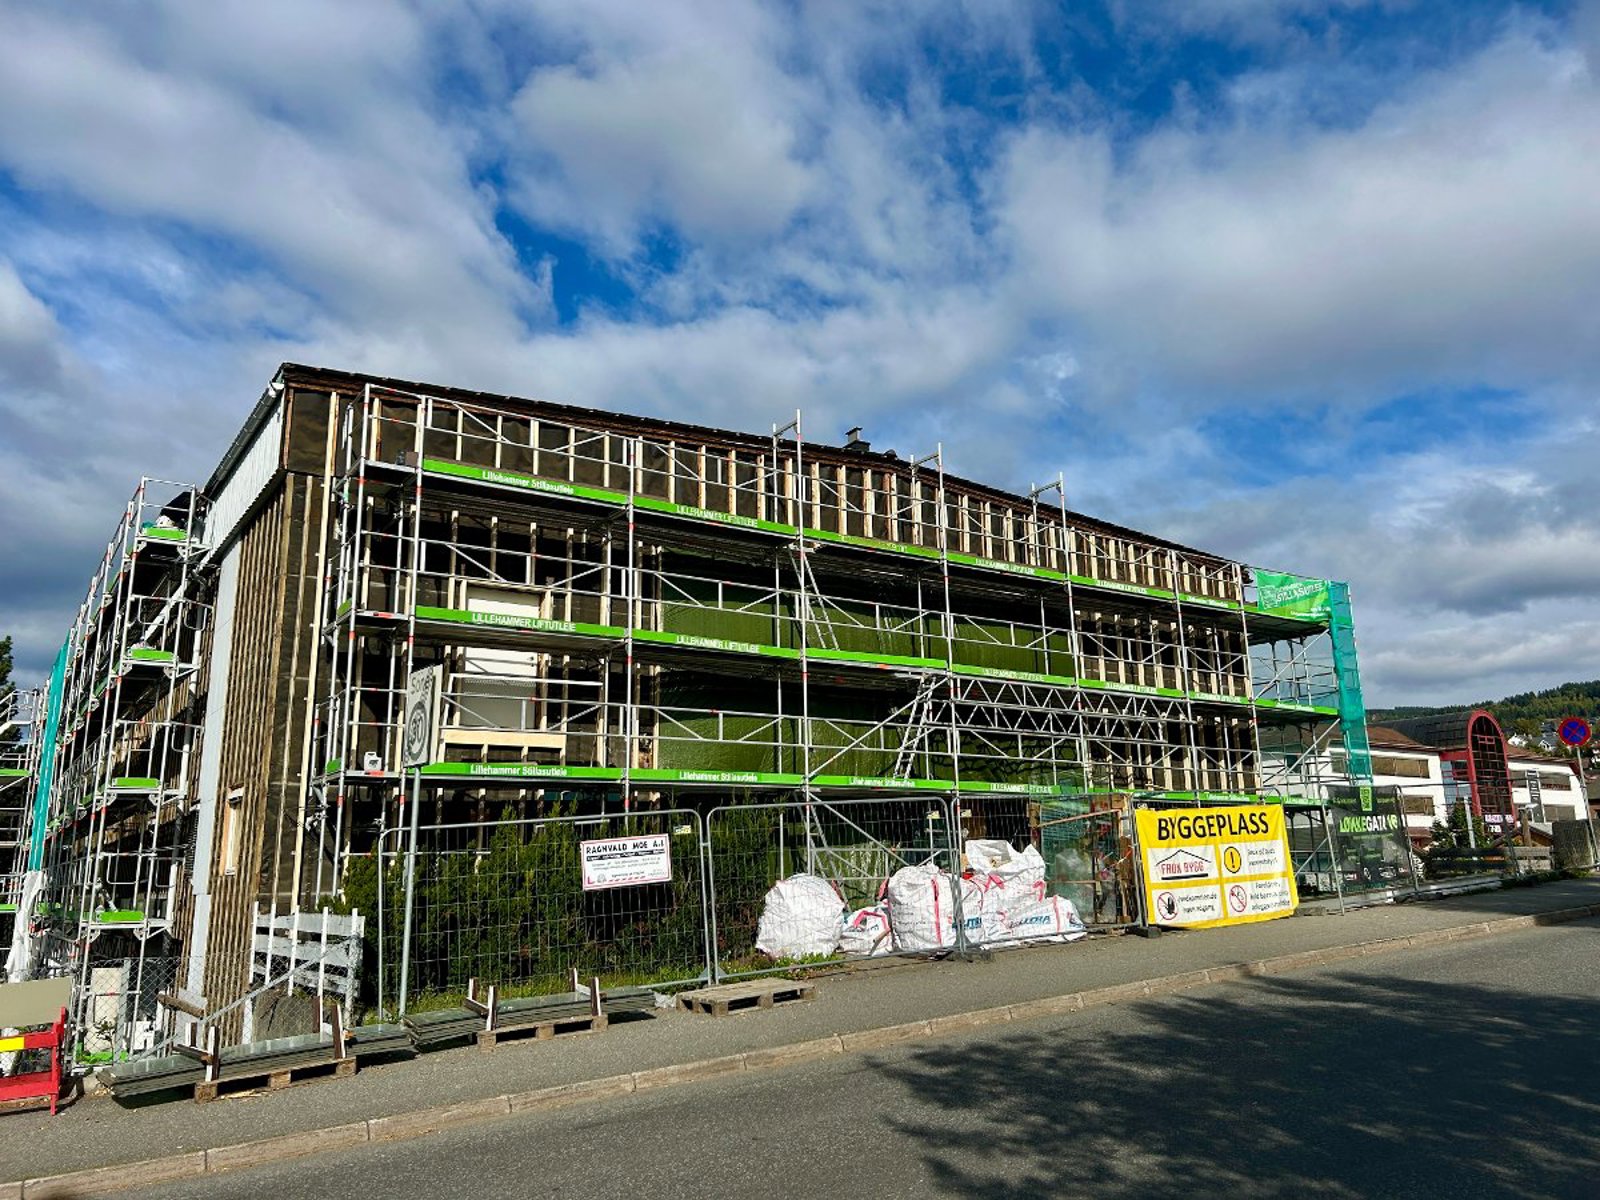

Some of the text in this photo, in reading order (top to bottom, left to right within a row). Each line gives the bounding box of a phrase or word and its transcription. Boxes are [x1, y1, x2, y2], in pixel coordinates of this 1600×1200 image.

[472, 612, 576, 632] LILLEHAMMER LIFTUTLEIE
[470, 763, 520, 775] Lillehammer
[1157, 812, 1269, 841] BYGGEPLASS
[586, 843, 628, 854] RAGNVALD
[632, 840, 648, 849] MOE
[1183, 861, 1205, 873] BYGG
